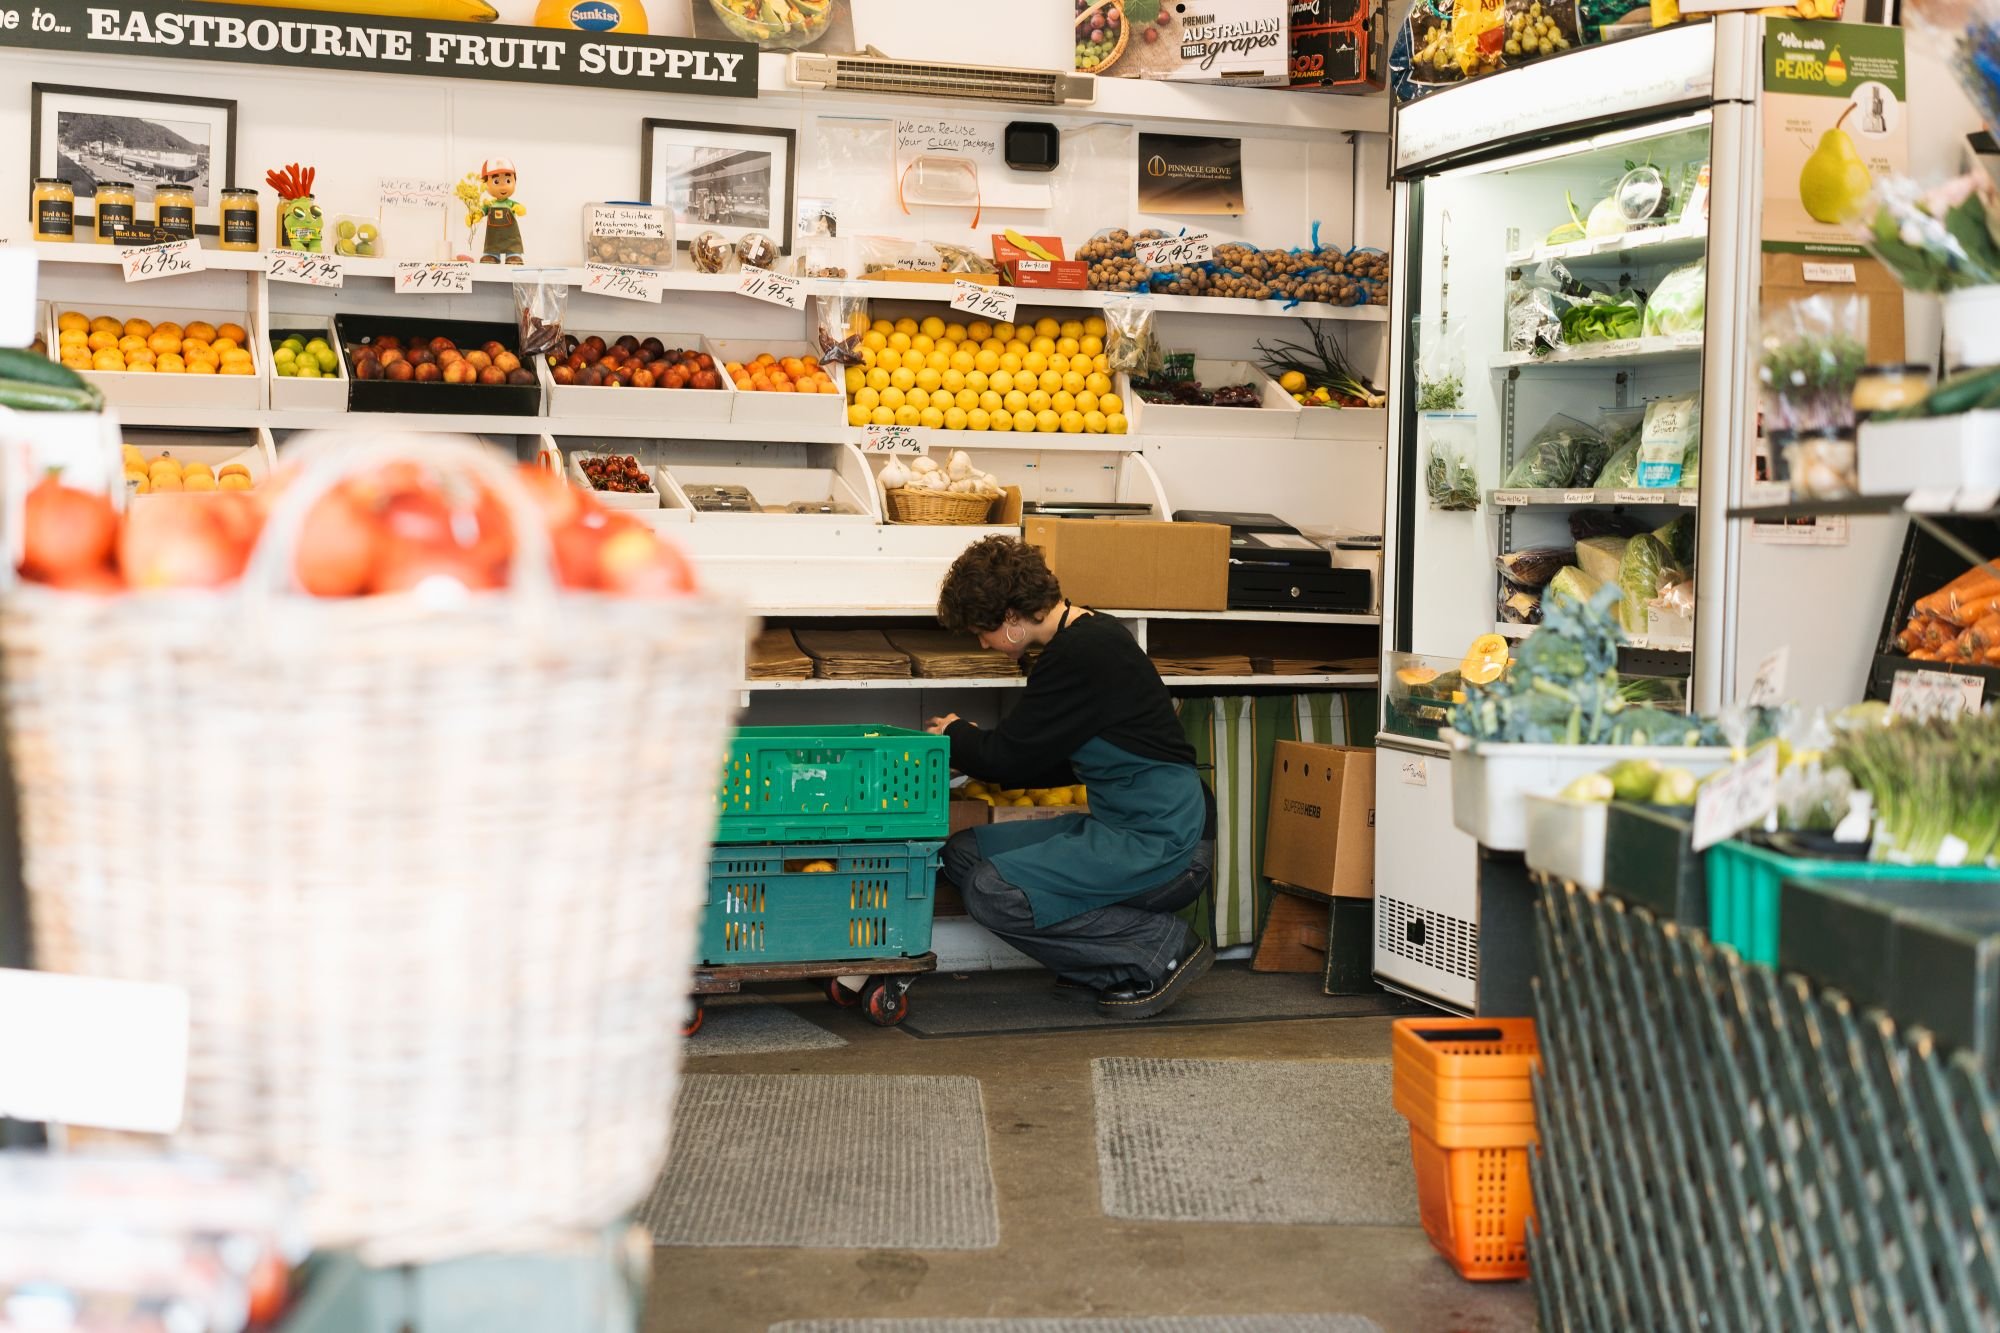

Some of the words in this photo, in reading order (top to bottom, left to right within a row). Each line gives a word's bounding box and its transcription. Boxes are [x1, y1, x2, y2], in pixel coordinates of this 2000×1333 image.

[31, 15, 71, 33] to...
[571, 10, 620, 25] Sunkist
[1182, 14, 1215, 27] PREMIUM
[1182, 17, 1280, 42] AUSTRALIAN
[87, 8, 412, 62] EASTBOURNE
[426, 32, 566, 72] FRUIT
[579, 43, 744, 83] SUPPLY
[1804, 38, 1826, 50] with
[1182, 44, 1206, 57] TABLE
[1200, 32, 1280, 71] grapes
[1776, 58, 1825, 82] PEARS
[899, 121, 914, 133] We
[918, 125, 934, 134] can
[1168, 164, 1204, 174] PINNACLE
[1205, 166, 1231, 175] GROVE
[381, 180, 413, 190] We're
[595, 209, 616, 219] Dried
[620, 210, 653, 220] Shiitake
[615, 228, 625, 236] per
[587, 263, 612, 271] YELLOW
[897, 258, 914, 269] Mung
[917, 258, 937, 267] Beans
